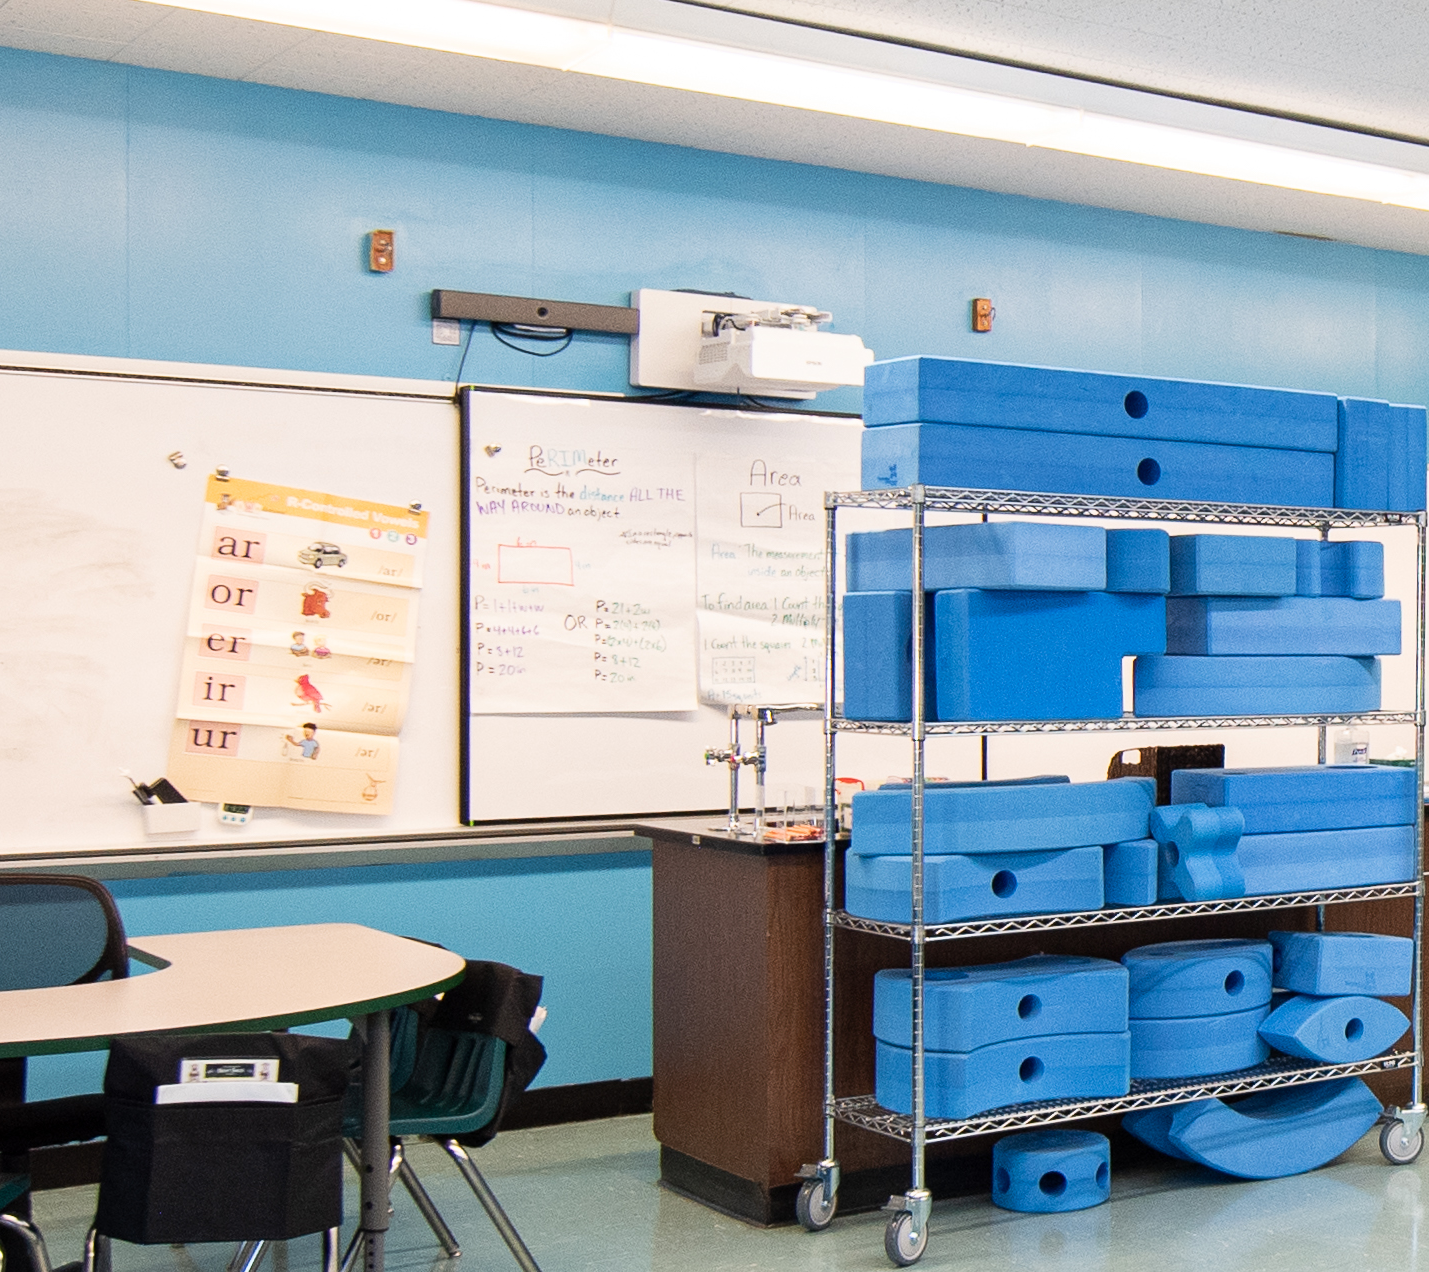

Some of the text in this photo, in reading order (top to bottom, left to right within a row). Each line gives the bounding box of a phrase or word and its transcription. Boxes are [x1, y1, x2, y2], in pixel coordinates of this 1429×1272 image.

[529, 445, 618, 468] PeRIMeter
[750, 459, 802, 486] Area
[476, 477, 686, 502] Perimeter is the distance ALL THE
[287, 496, 369, 521] R-Controlled
[372, 511, 420, 529] Vowels
[476, 501, 506, 515] WAY
[511, 500, 566, 515] AROUND
[583, 504, 621, 521] object
[789, 504, 816, 521] Area
[217, 535, 404, 578] ar /ar/
[744, 544, 763, 558] The
[210, 584, 398, 623] or /or/
[702, 594, 715, 611] To
[744, 600, 769, 611] area
[564, 614, 588, 631] OR
[206, 631, 246, 654] er
[742, 635, 757, 649] the
[202, 676, 236, 702] ir
[191, 727, 238, 750] ur
